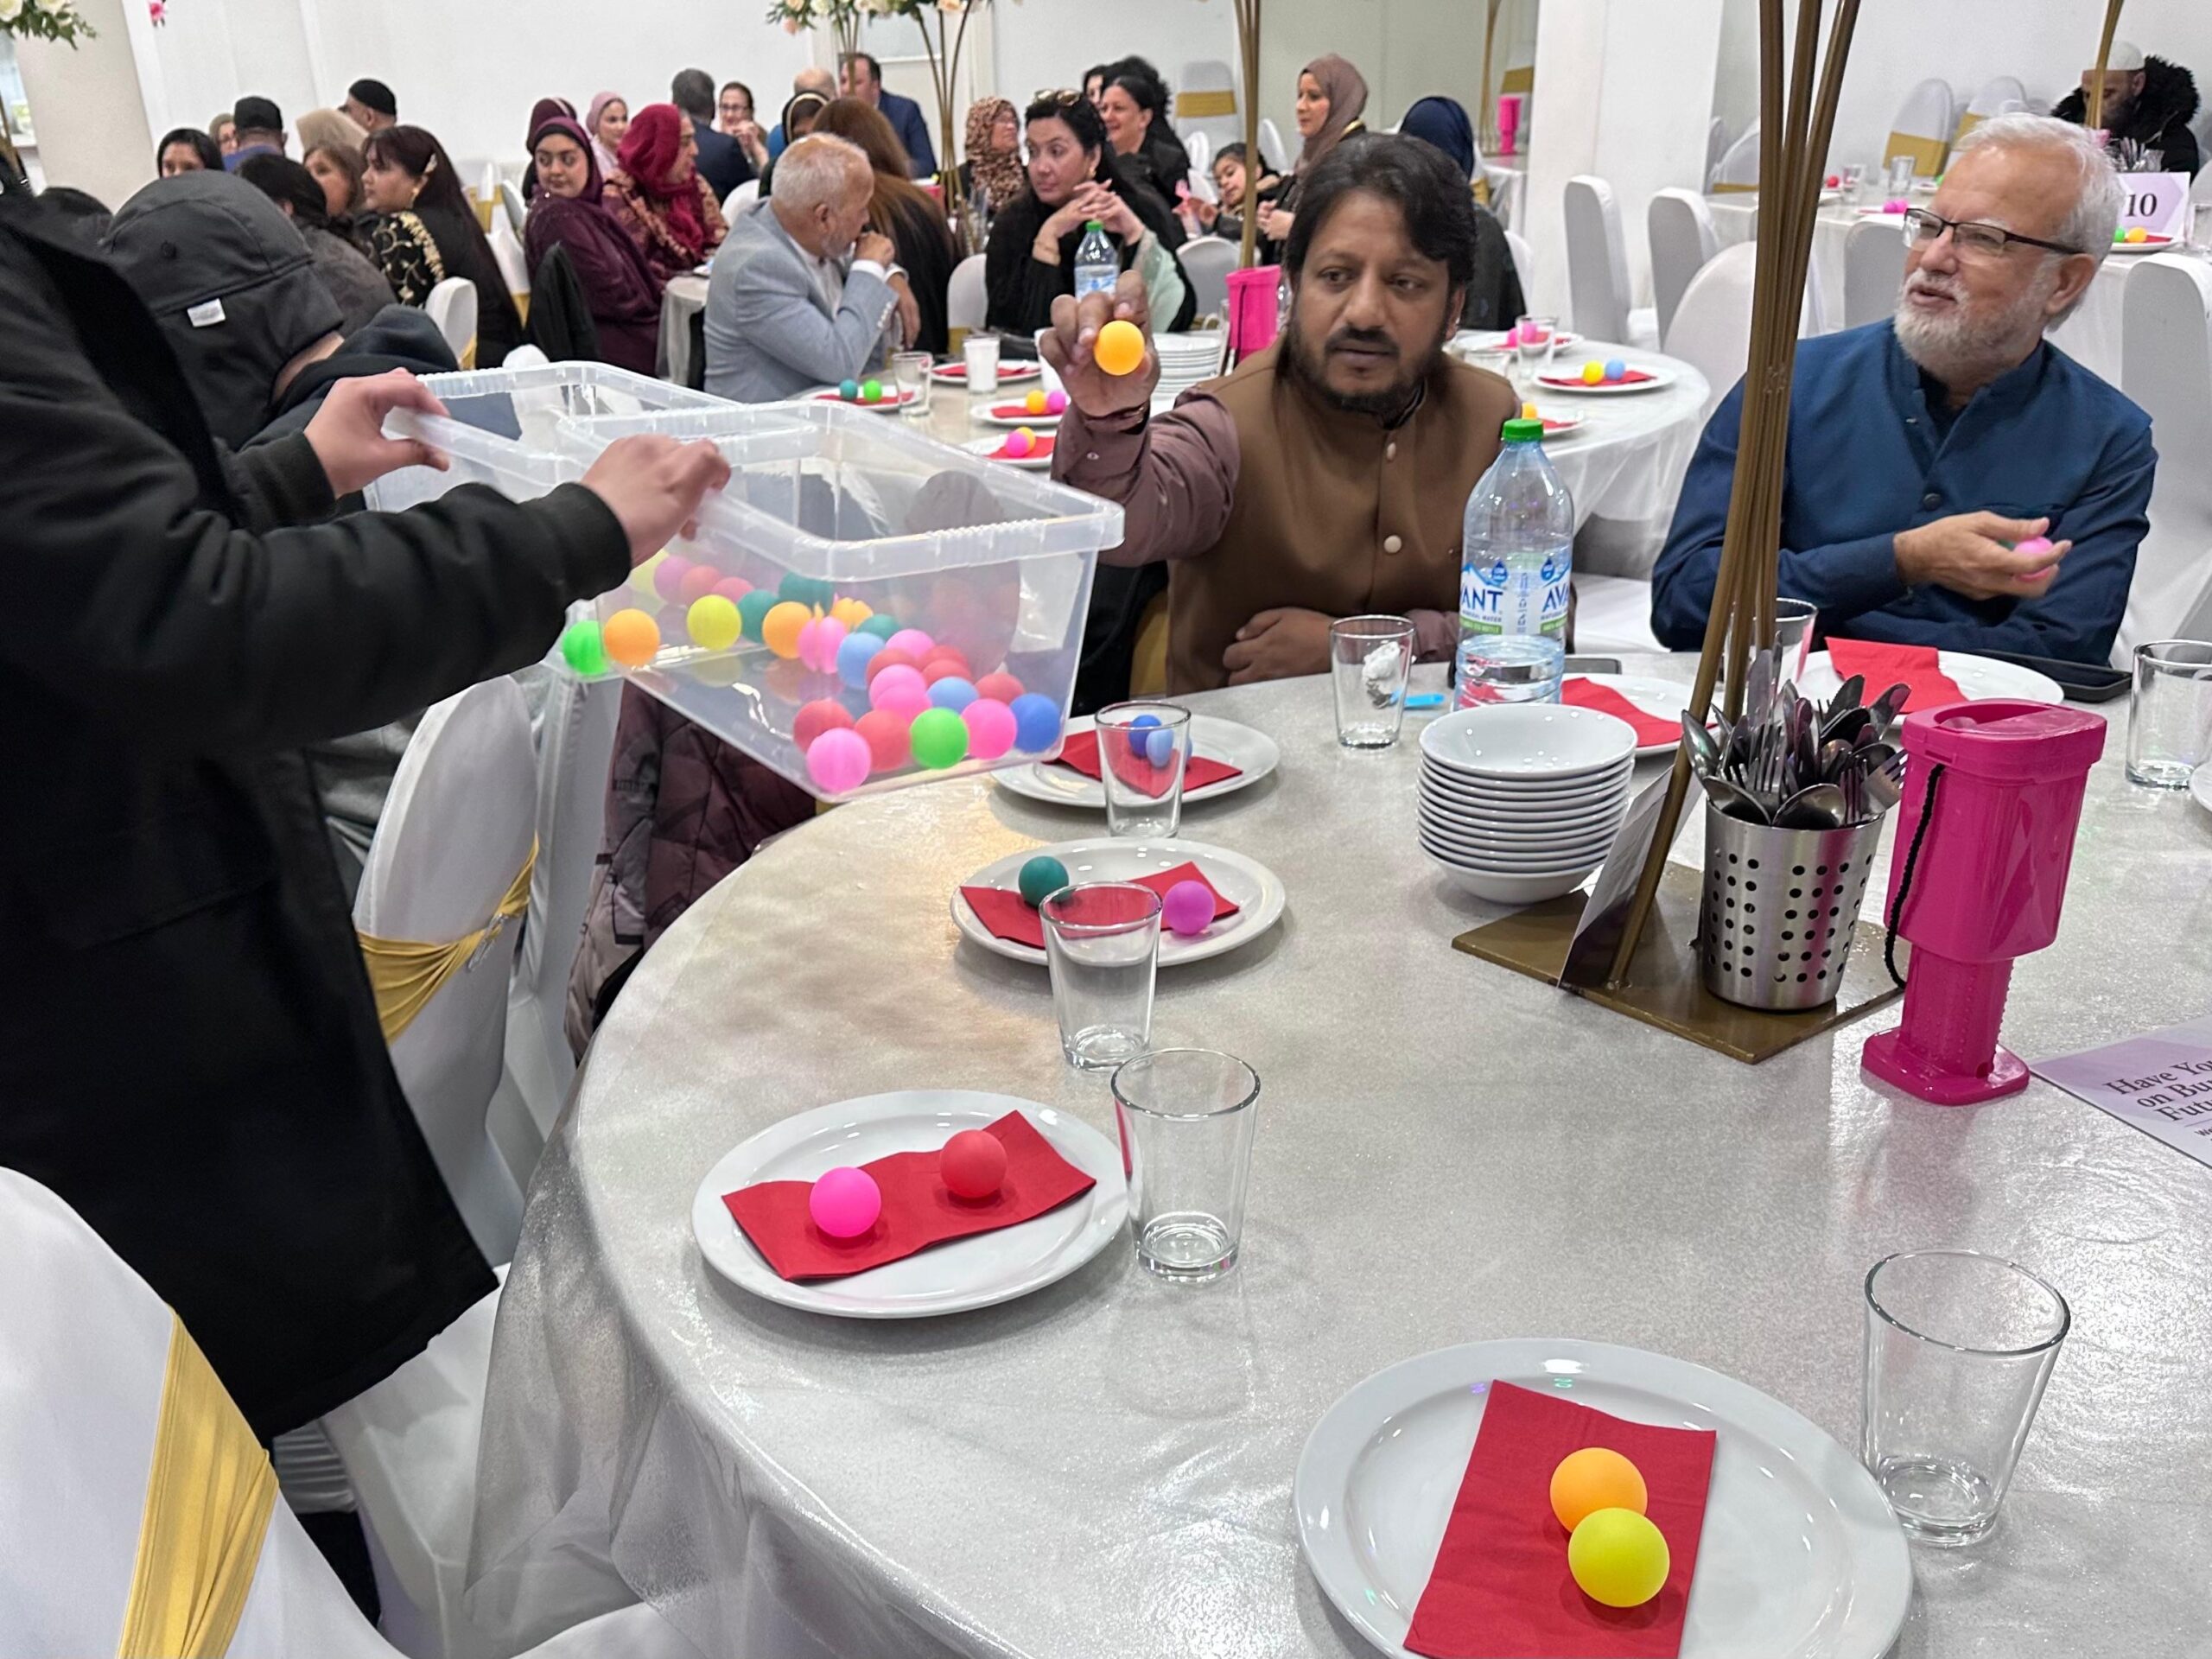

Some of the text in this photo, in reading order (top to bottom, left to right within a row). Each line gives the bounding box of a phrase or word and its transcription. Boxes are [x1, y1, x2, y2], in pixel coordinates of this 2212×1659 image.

[2125, 193, 2158, 217] 10
[1461, 585, 1503, 613] ANT
[2102, 1071, 2178, 1095] Have
[2137, 1080, 2212, 1109] on Bu
